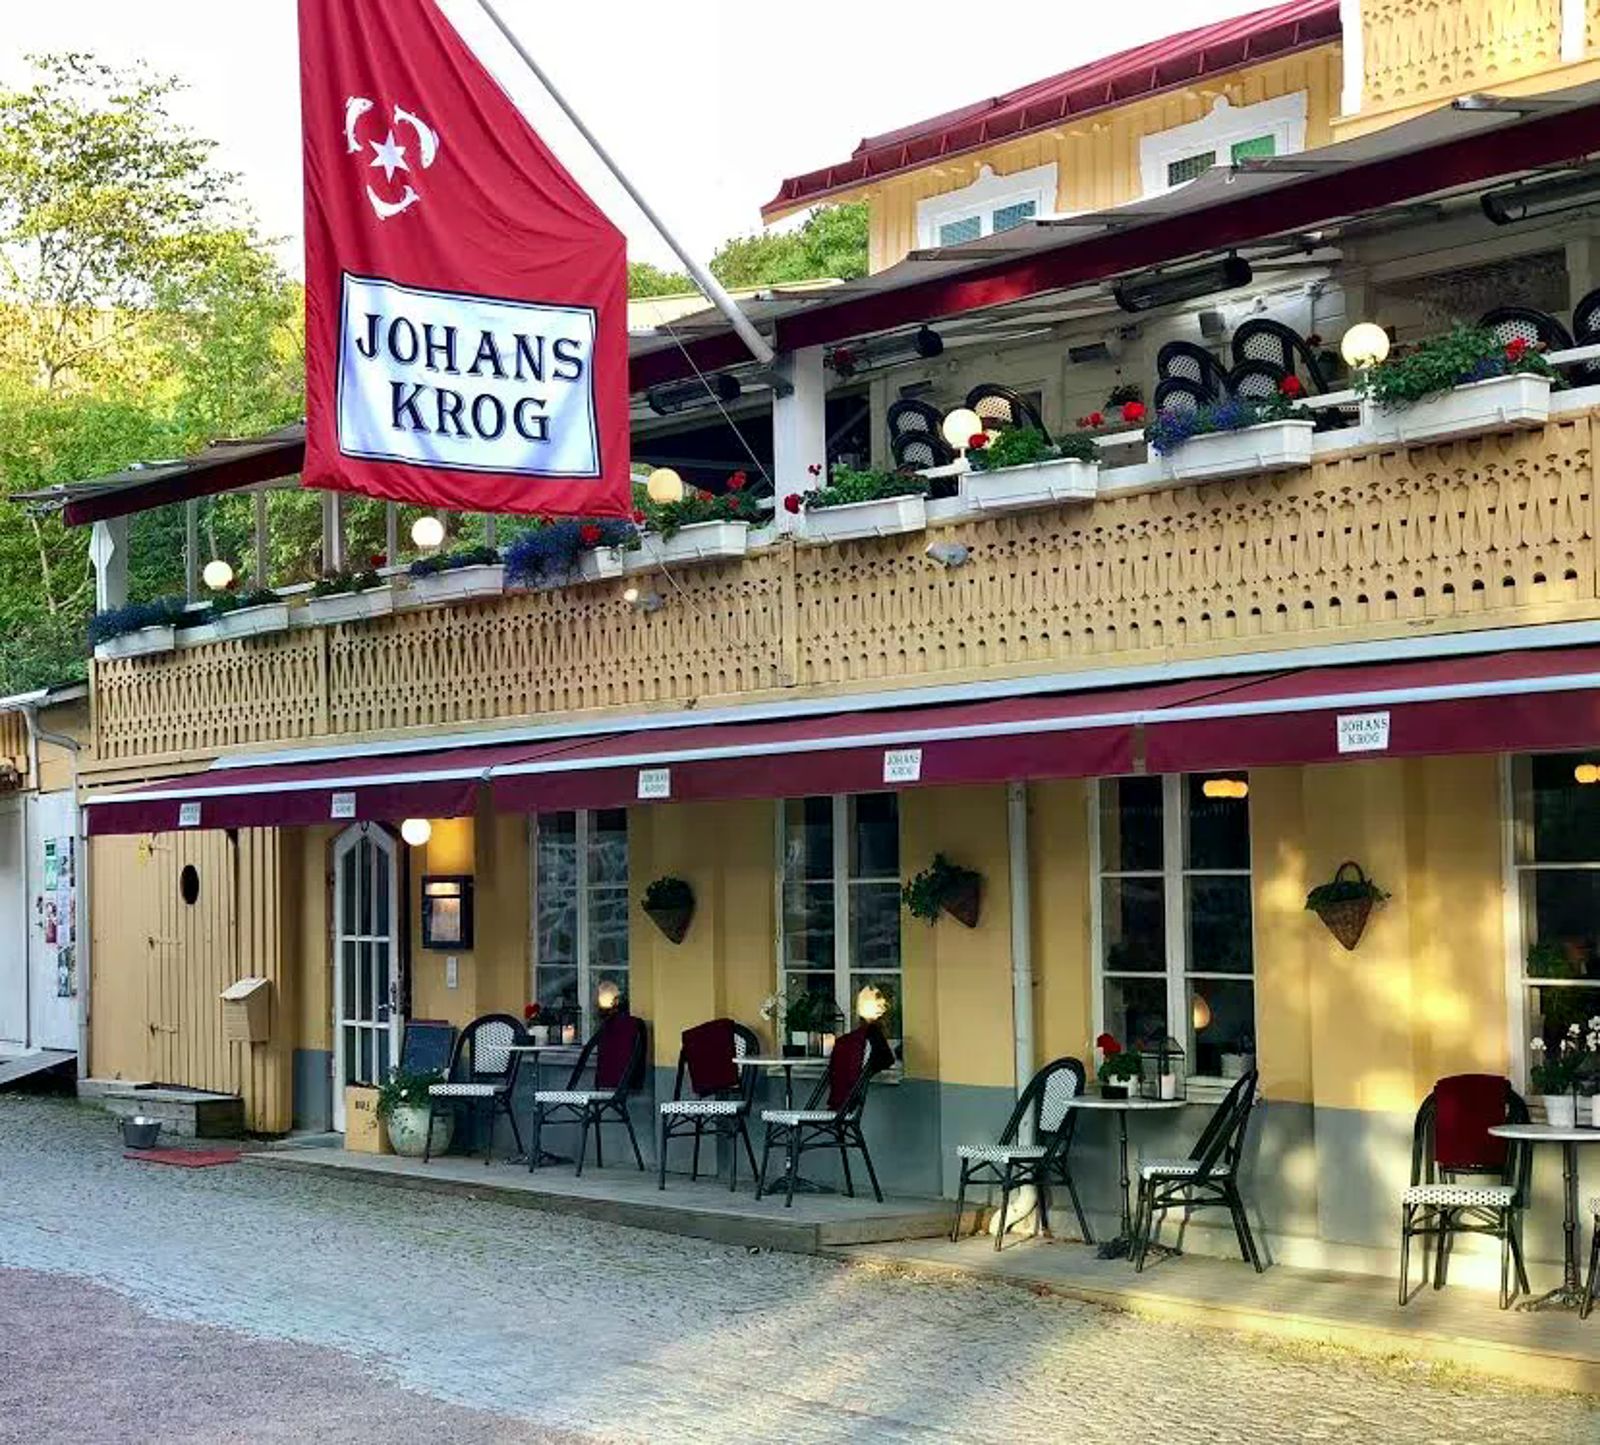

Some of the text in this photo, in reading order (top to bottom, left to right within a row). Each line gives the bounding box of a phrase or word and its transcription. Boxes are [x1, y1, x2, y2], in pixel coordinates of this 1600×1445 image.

[355, 313, 583, 382] JOHANS
[389, 380, 550, 443] KROG
[1341, 718, 1388, 732] JOHANS
[1348, 731, 1380, 745] KROG
